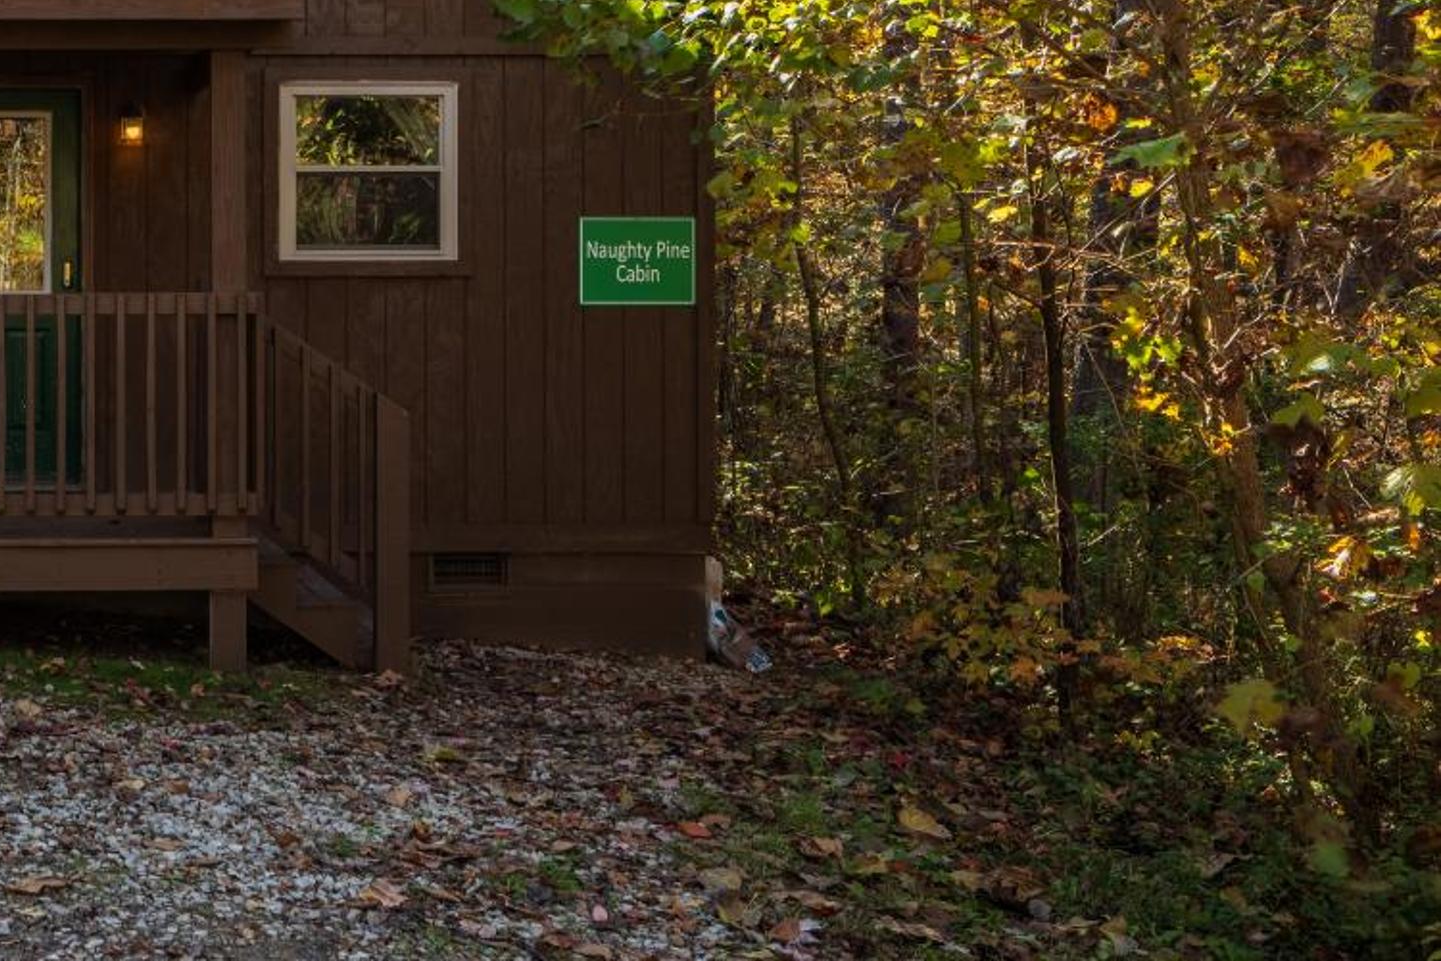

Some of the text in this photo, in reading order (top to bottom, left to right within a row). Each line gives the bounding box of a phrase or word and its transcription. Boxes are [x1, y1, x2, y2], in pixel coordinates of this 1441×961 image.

[586, 240, 691, 263] Naughty Pine
[616, 264, 660, 283] Cabin
